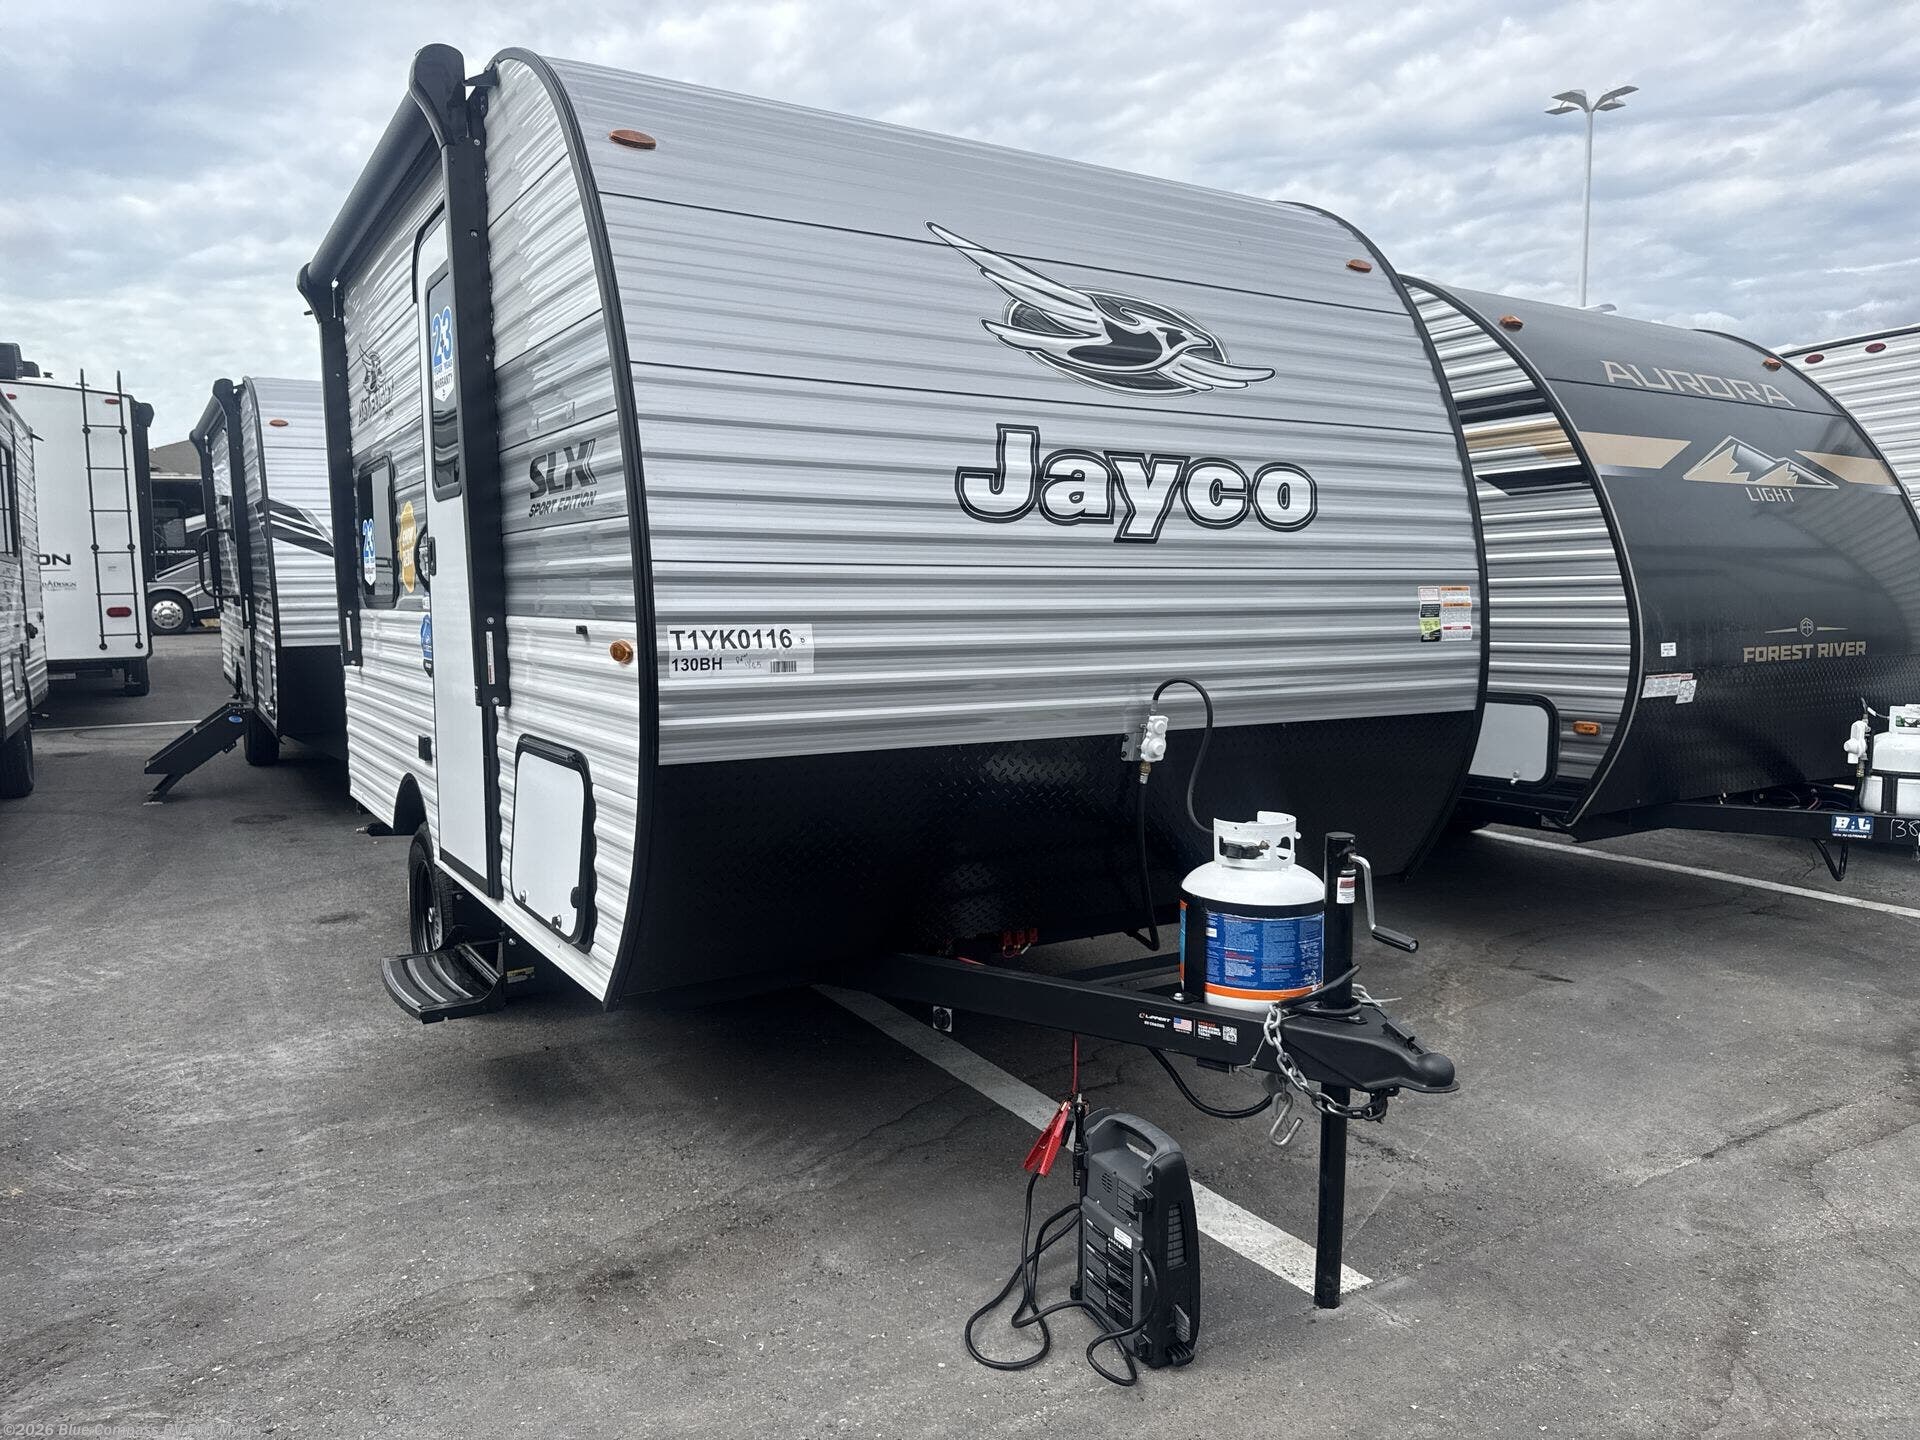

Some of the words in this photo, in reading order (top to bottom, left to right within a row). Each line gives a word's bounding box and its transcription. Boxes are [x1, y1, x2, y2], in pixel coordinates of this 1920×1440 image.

[1600, 360, 1796, 408] AURORA
[529, 438, 597, 499] SLX
[955, 423, 1318, 544] Jayco
[1745, 487, 1795, 503] LIGHT
[528, 499, 558, 518] SPORT
[557, 490, 597, 512] EDITION
[669, 629, 793, 651] T1YK0116
[1743, 644, 1814, 663] FOREST
[1817, 641, 1867, 658] RIVER
[671, 657, 723, 672] 130BH
